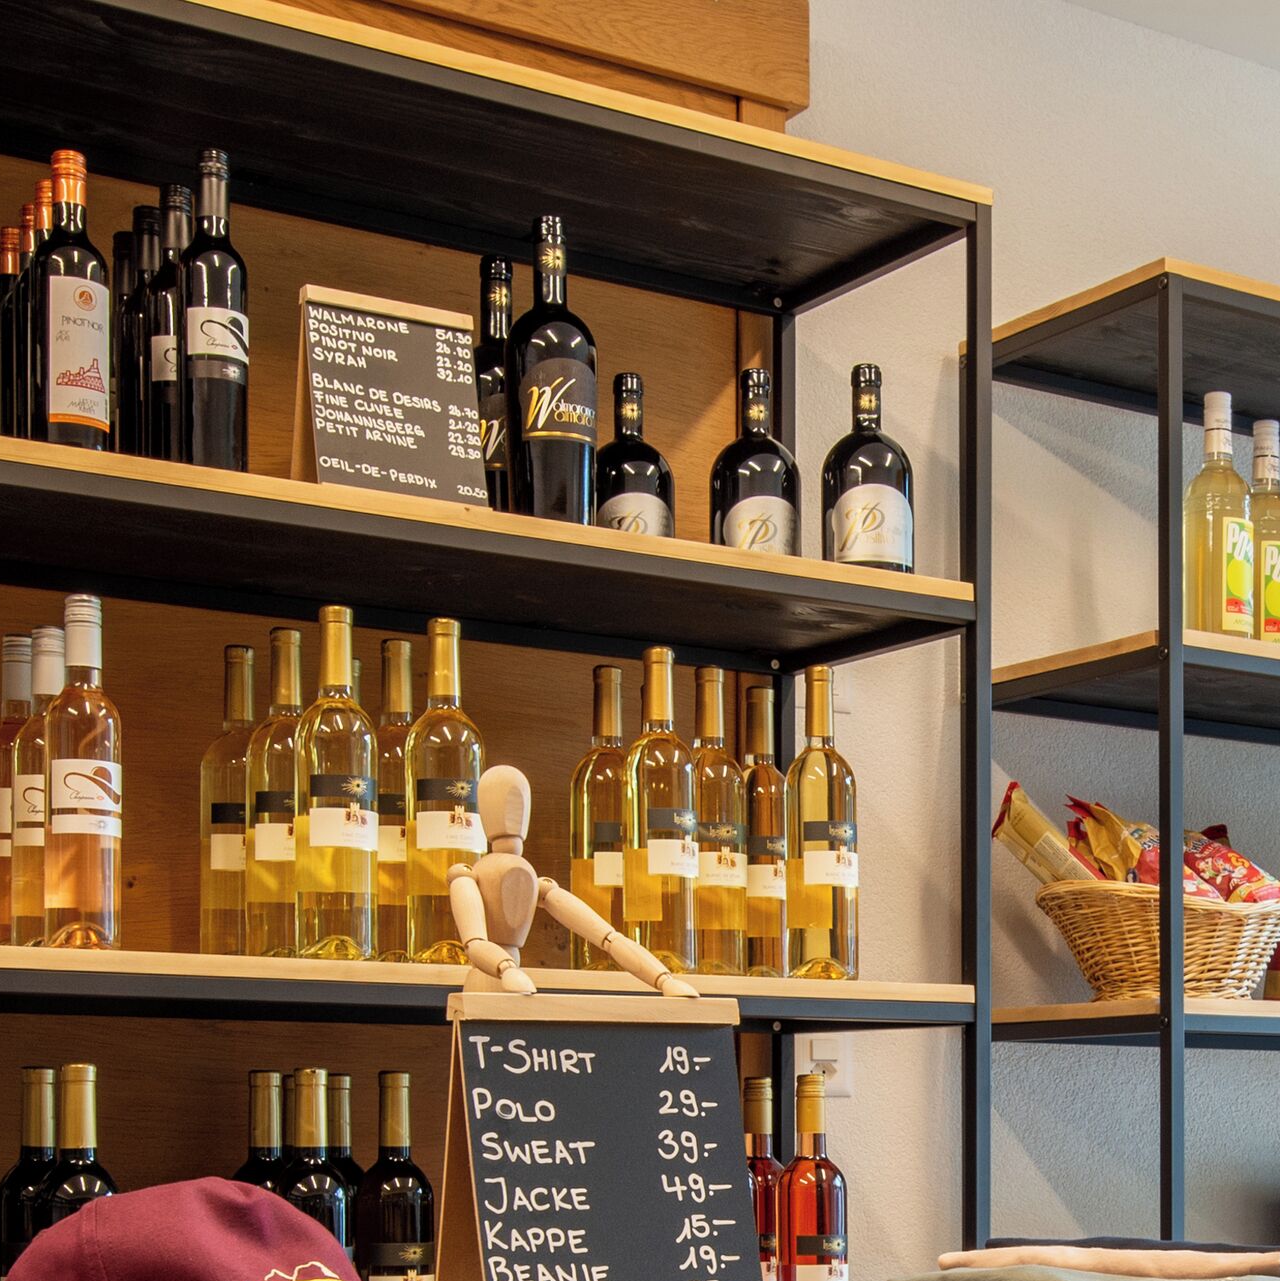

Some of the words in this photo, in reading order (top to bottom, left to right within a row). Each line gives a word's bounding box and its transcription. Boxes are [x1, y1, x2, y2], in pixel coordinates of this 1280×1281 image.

[308, 306, 410, 334] WALMARONE
[435, 328, 472, 345] 51.30
[308, 319, 375, 343] POSITIVO
[309, 332, 357, 353] PINOT
[362, 344, 398, 362] NOIR
[436, 356, 472, 373] 22.20
[312, 347, 367, 368] SYRAH
[312, 372, 364, 396] BLANC
[369, 388, 389, 402] DE
[393, 391, 441, 413] DESIRS
[313, 390, 348, 408] FINE
[354, 400, 404, 420] CUVEE
[315, 404, 425, 438] JOHANNISBERG
[447, 431, 482, 446] 22.30
[315, 418, 358, 438] PETIT
[365, 429, 417, 449] ARVINE
[319, 455, 437, 489] OEIL-DE-PERDIX
[469, 1035, 596, 1074] T-SHIRT
[472, 1088, 556, 1122] POLO
[481, 1131, 596, 1165] SWEAT
[484, 1176, 590, 1215] JACKE
[484, 1220, 589, 1255] KAPPE
